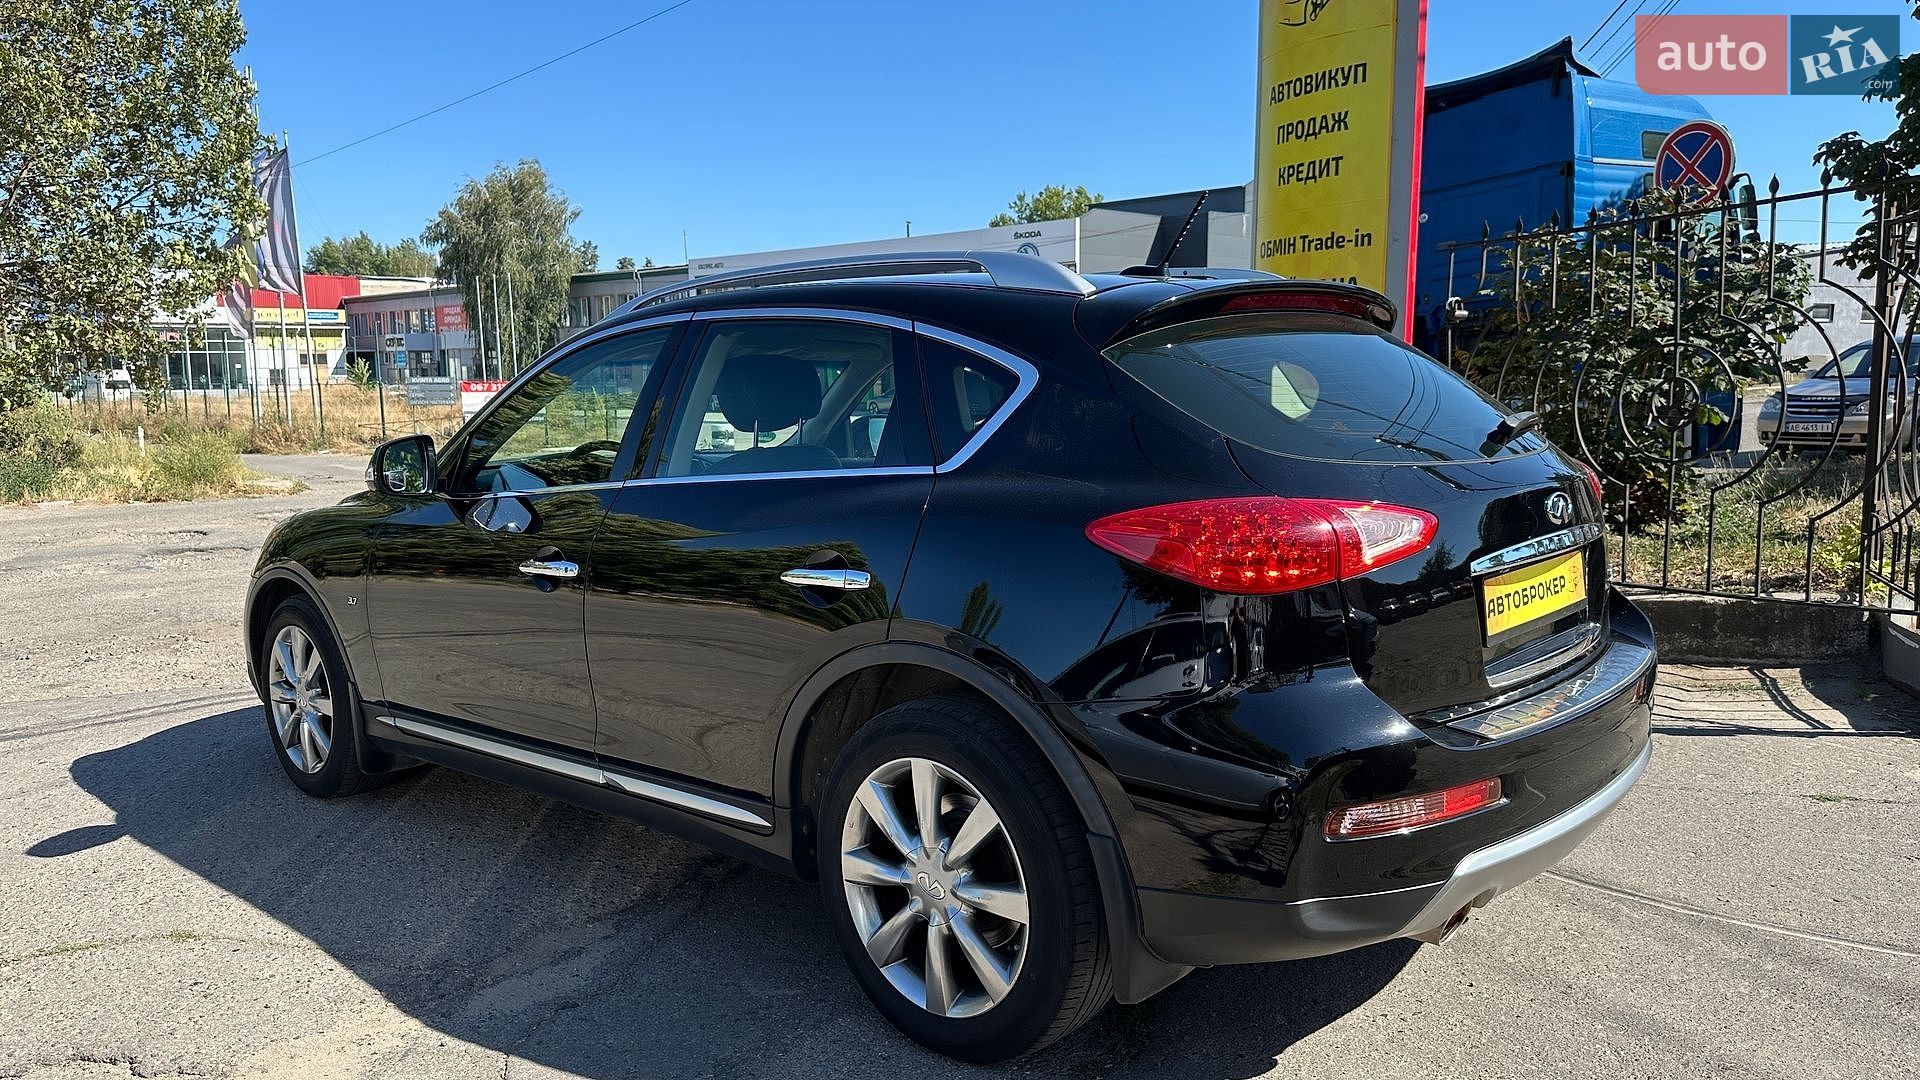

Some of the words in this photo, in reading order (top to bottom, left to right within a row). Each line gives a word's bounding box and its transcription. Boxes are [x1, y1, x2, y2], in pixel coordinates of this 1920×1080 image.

[1269, 62, 1367, 106] АВТОВИКУП
[1277, 110, 1349, 145] ПРОДАЖ
[1278, 156, 1344, 187] КРЕДИТ
[1013, 230, 1042, 240] ŠKODA
[1260, 236, 1296, 259] ОБМІН
[1299, 228, 1372, 254] Trade-in
[470, 383, 490, 391] 067
[1487, 575, 1566, 618] АВТОБРОКЕР
